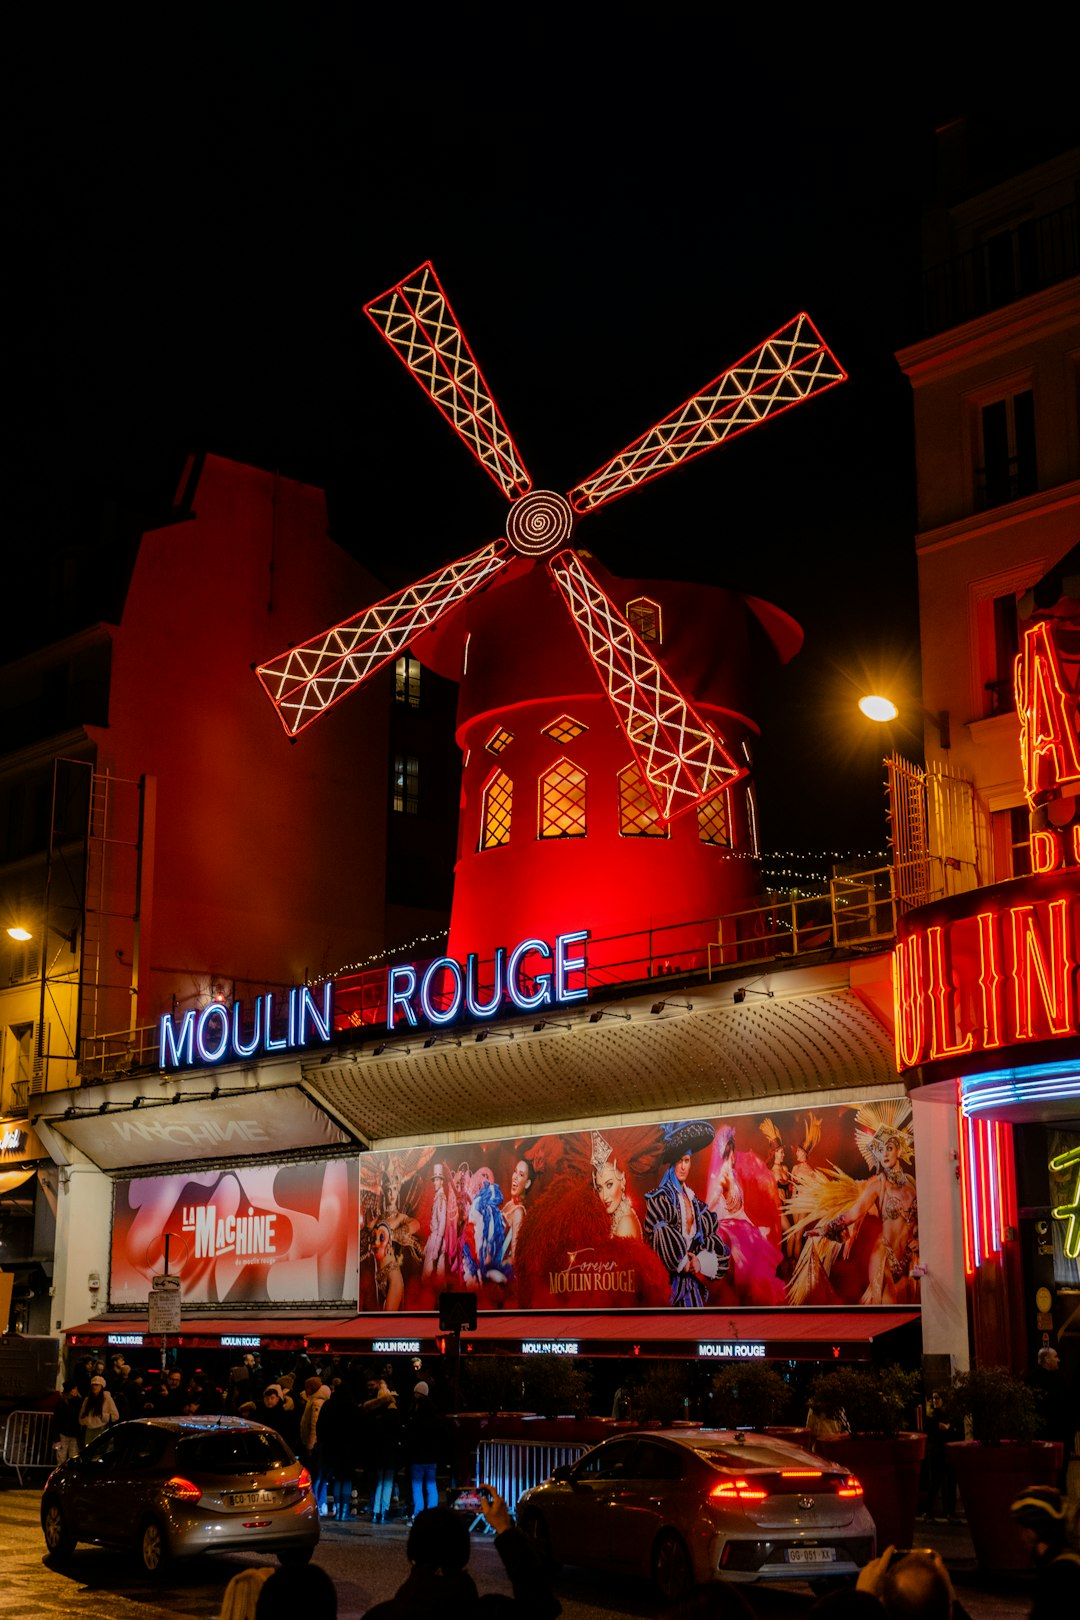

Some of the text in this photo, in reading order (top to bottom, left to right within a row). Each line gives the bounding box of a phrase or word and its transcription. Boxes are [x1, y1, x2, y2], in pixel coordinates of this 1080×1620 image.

[892, 899, 1069, 1073] ULIN
[159, 929, 590, 1069] MOULIN ROUGE
[183, 1207, 195, 1226] LA
[561, 1248, 618, 1273] Forever
[549, 1269, 635, 1294] MOULIN ROUGE
[108, 1335, 126, 1345] MOULIN
[221, 1337, 260, 1347] MOULIN ROUGE
[372, 1342, 420, 1352] MOULIN ROUGE
[522, 1343, 578, 1354] MOULIN ROUGE
[699, 1344, 766, 1357] MOULIN ROUGE
